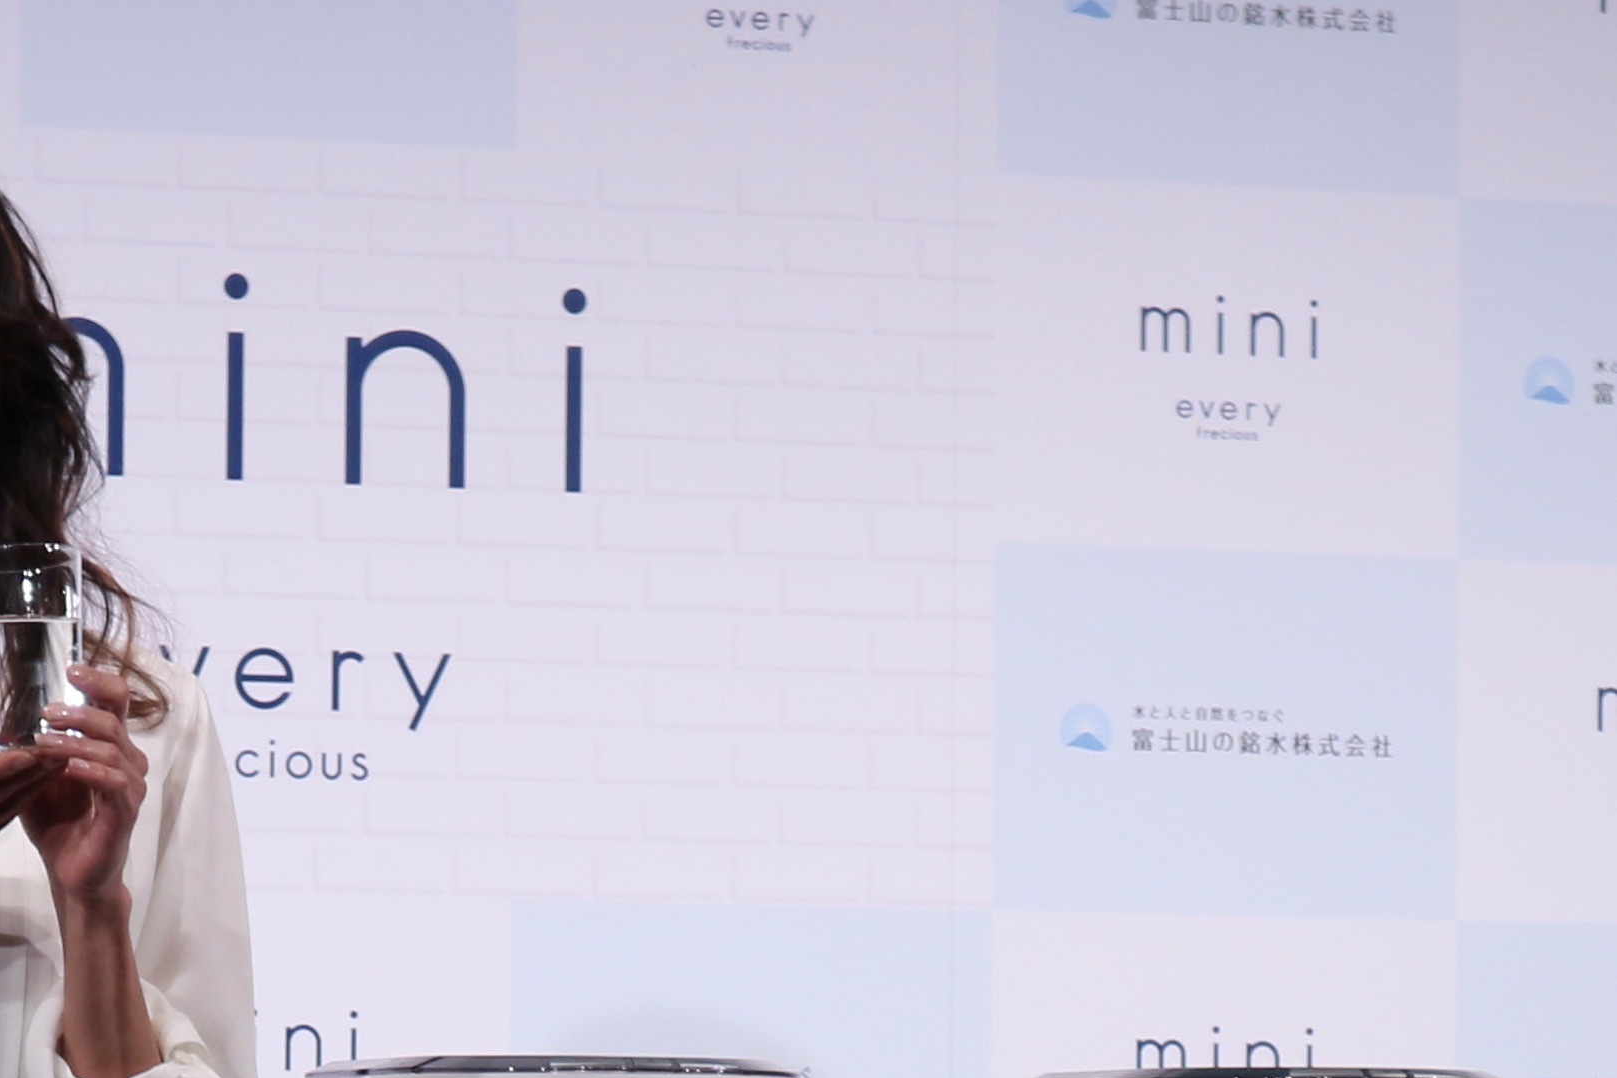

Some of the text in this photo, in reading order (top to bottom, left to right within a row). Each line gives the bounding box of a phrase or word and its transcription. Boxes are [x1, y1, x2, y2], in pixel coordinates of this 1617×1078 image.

[705, 9, 814, 36] every
[1140, 295, 1318, 359] mini
[1175, 400, 1281, 426] every
[1132, 728, 1392, 758] 富士山の銘水株式会社
[235, 740, 368, 781] cious
